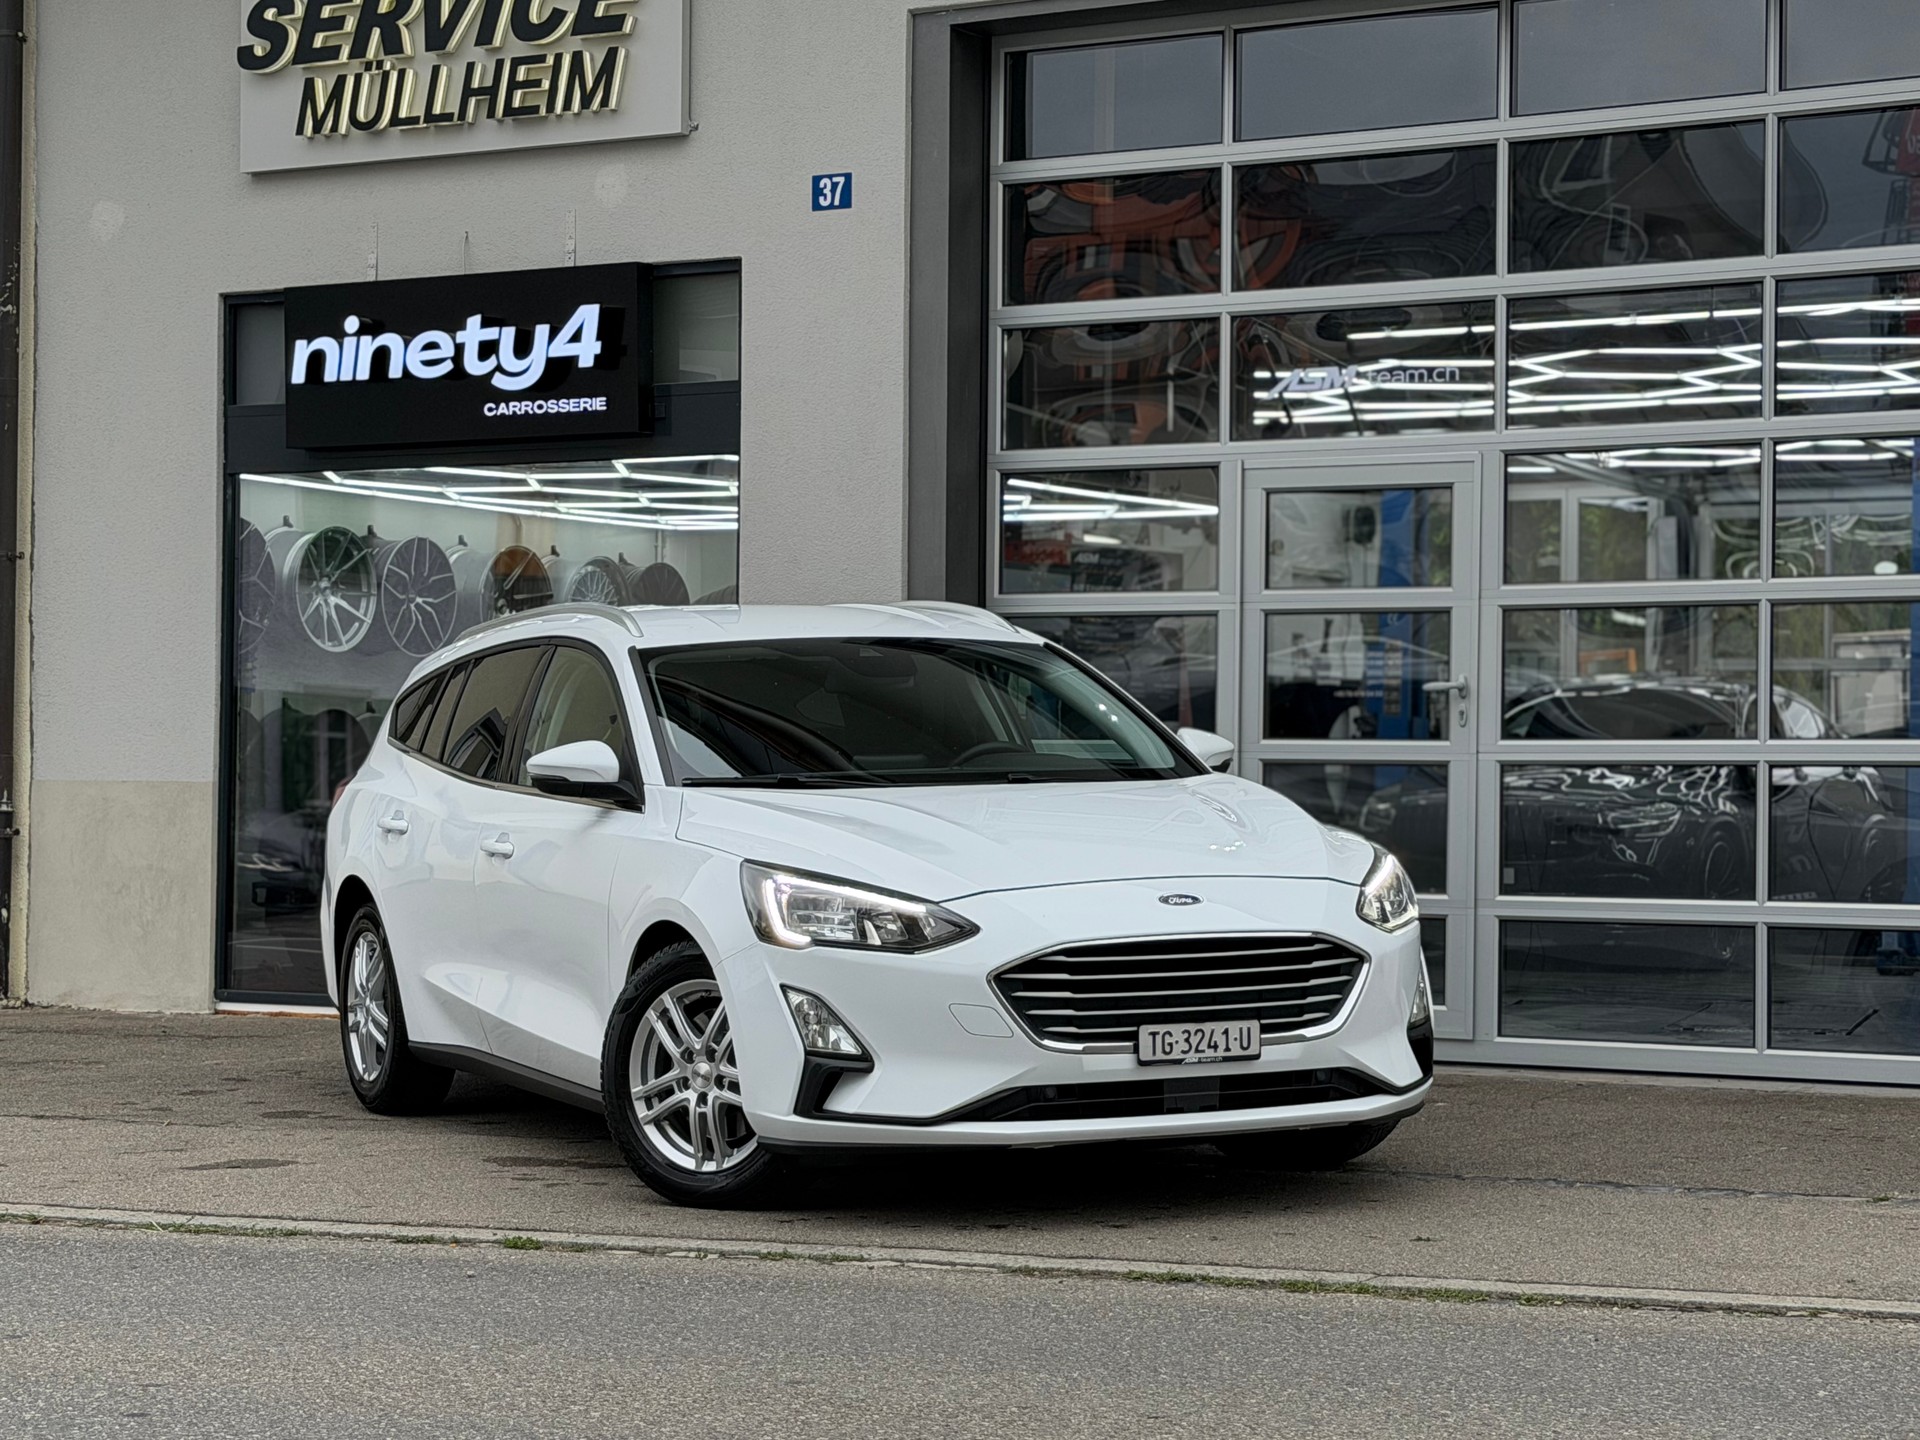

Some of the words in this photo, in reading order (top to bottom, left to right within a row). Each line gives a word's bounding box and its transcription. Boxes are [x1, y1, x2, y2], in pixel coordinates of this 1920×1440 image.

[296, 46, 628, 138] MÜLLHEIM
[818, 176, 846, 207] 37
[291, 303, 603, 391] ninety4
[483, 397, 607, 417] CARROSSERIE
